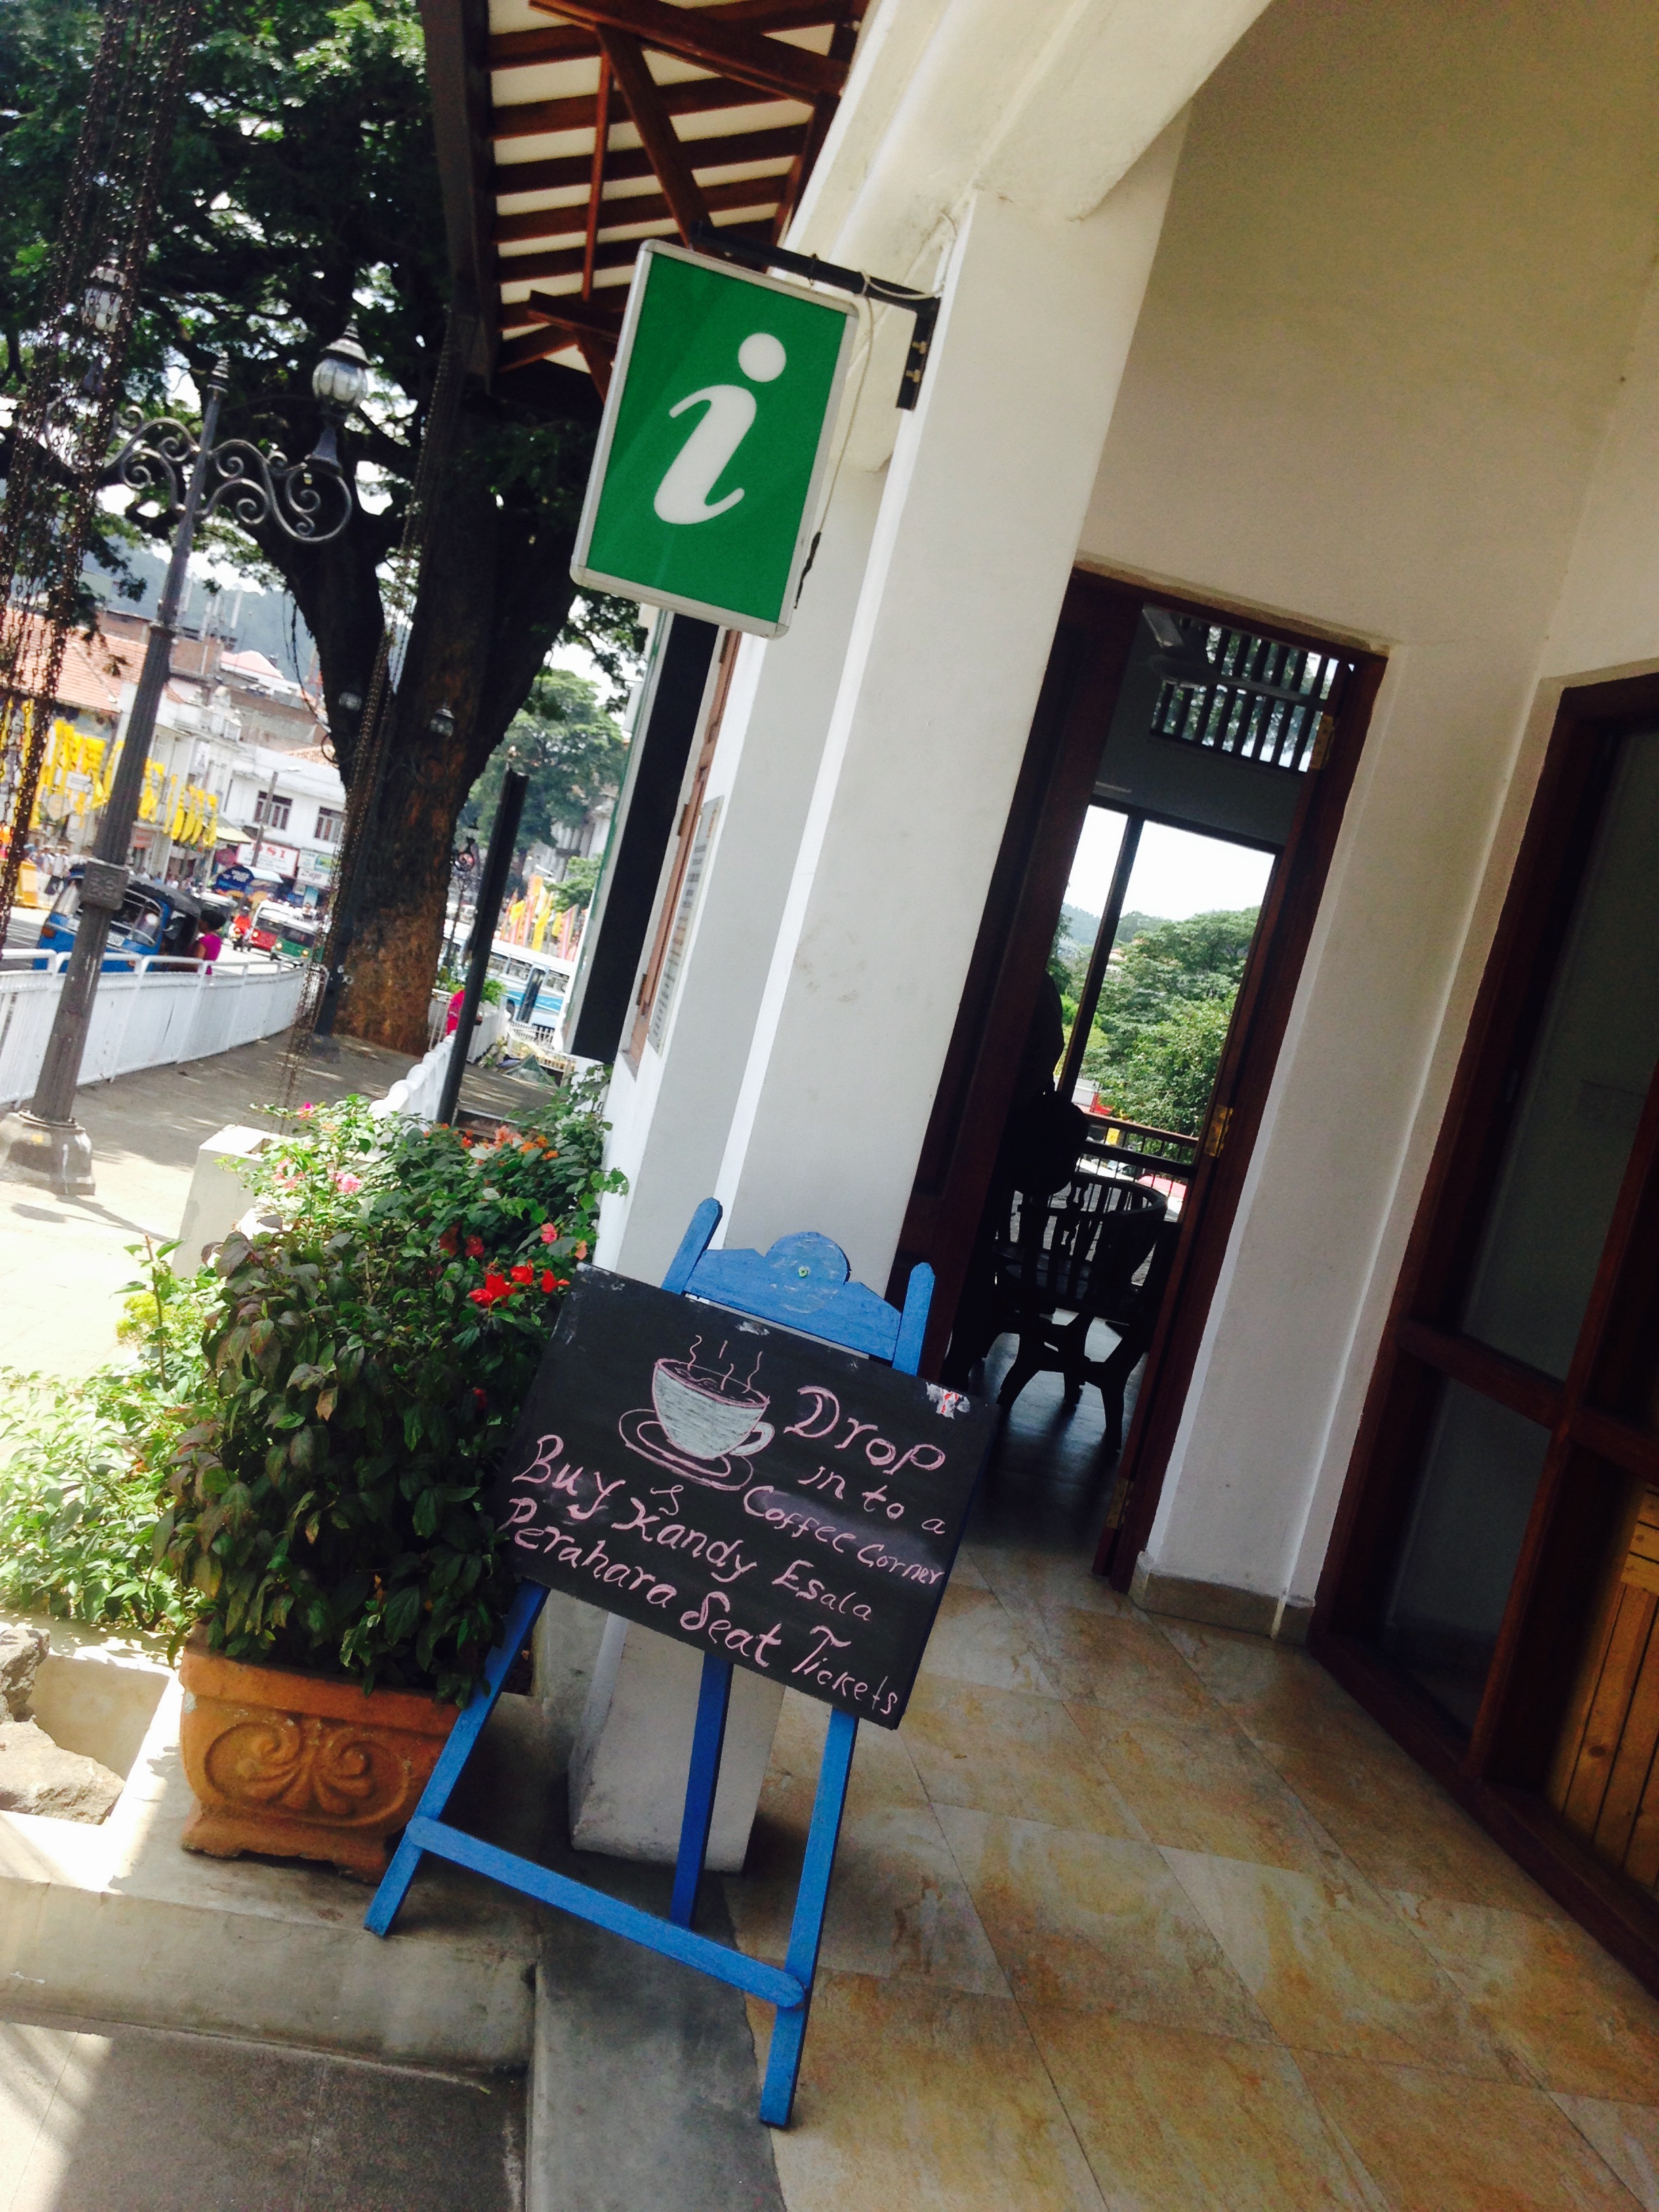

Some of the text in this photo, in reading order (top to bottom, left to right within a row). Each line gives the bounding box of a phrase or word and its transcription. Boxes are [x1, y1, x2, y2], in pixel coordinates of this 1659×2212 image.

[783, 1385, 947, 1476] Drop
[511, 1434, 872, 1622] Buy Kandy Esala
[743, 1485, 945, 1585] Coffee Corner
[861, 1484, 905, 1520] to
[921, 1517, 946, 1535] a
[495, 1497, 899, 1715] Perahara Seat Tickets
